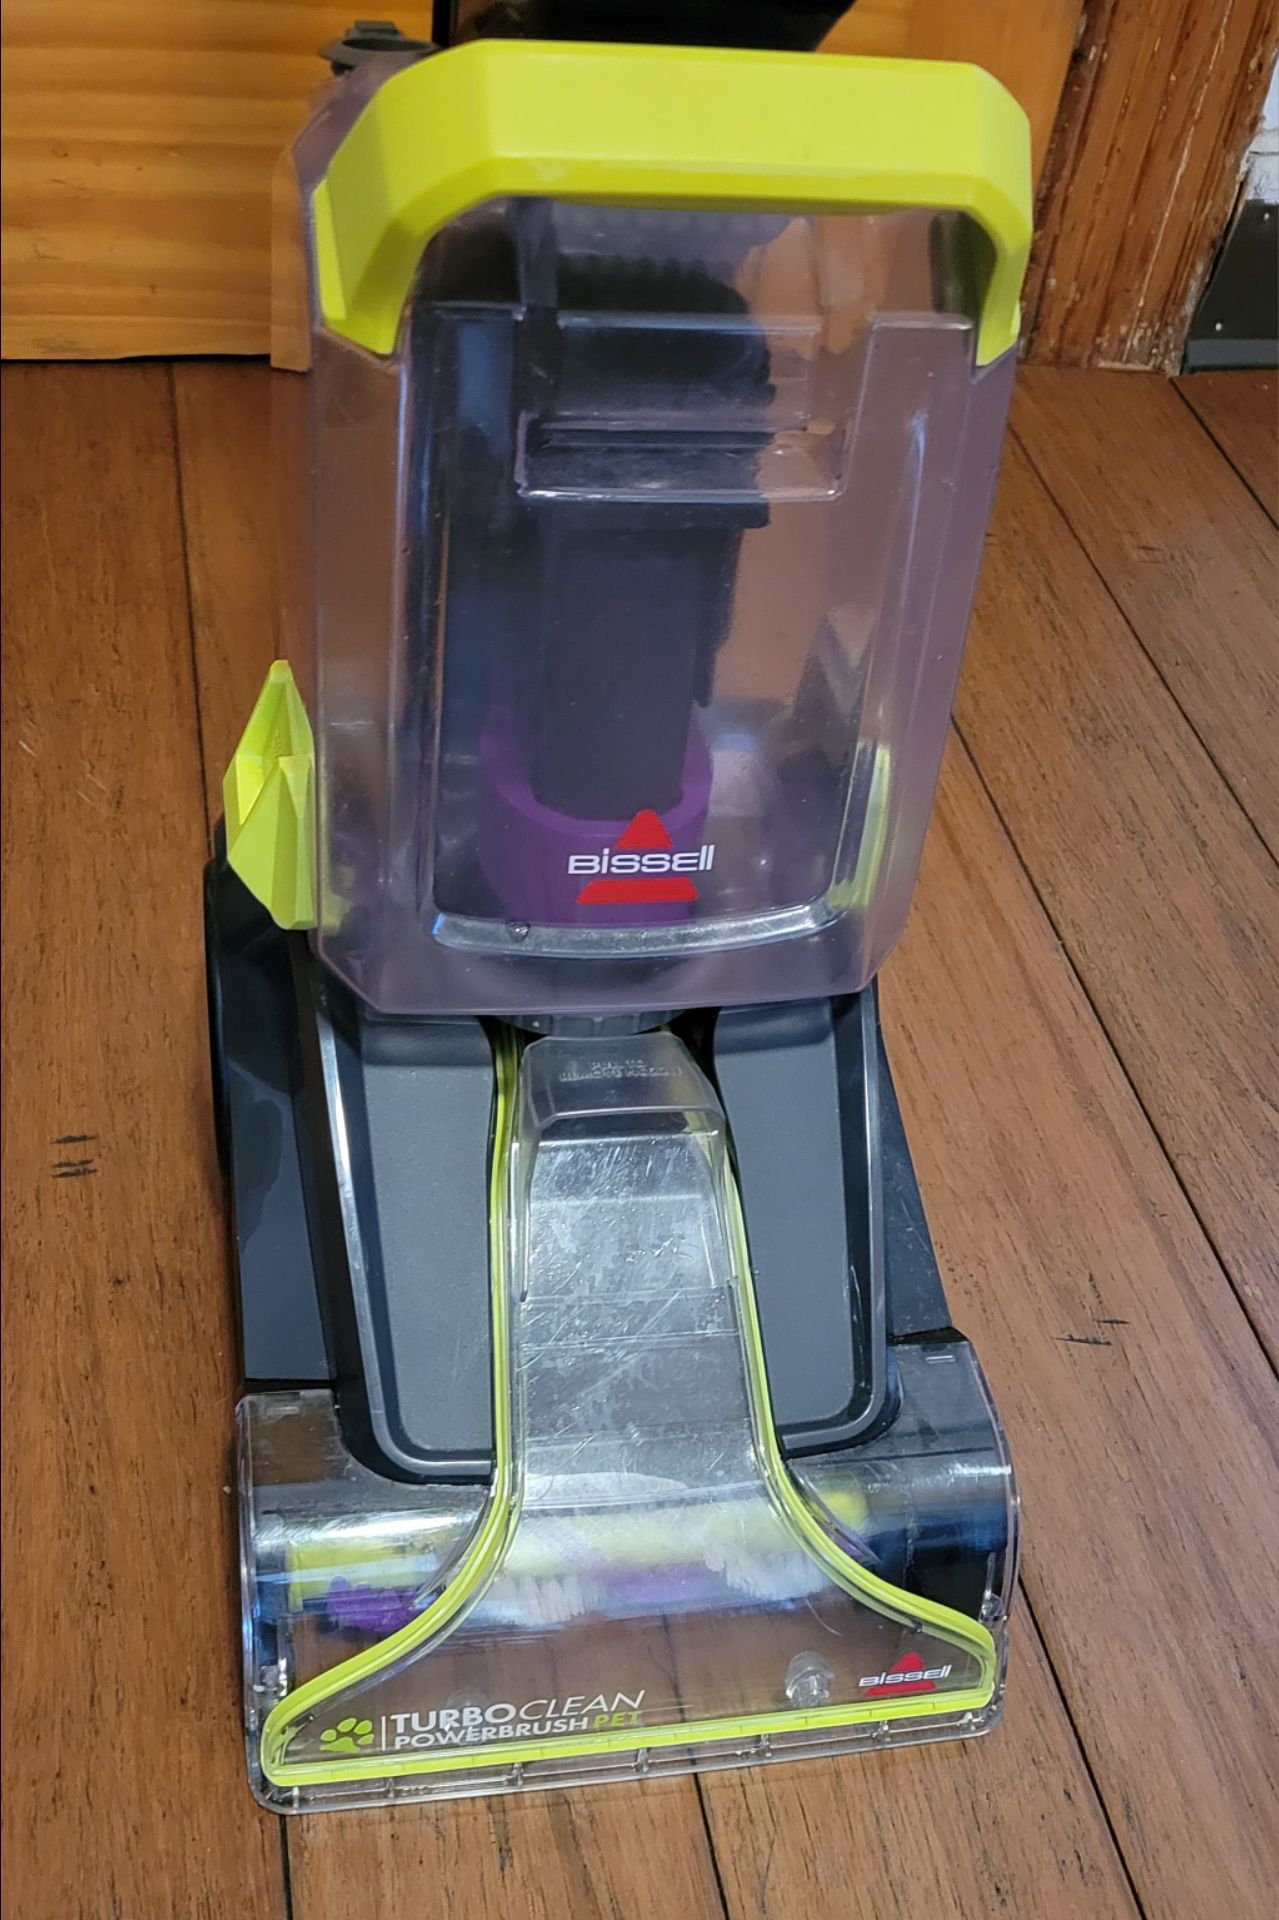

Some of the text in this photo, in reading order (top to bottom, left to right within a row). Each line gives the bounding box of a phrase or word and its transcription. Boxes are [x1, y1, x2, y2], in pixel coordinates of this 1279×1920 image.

[390, 1689, 646, 1734] TURBOCLEAN
[395, 1710, 642, 1750] POWERBRUSH PET
